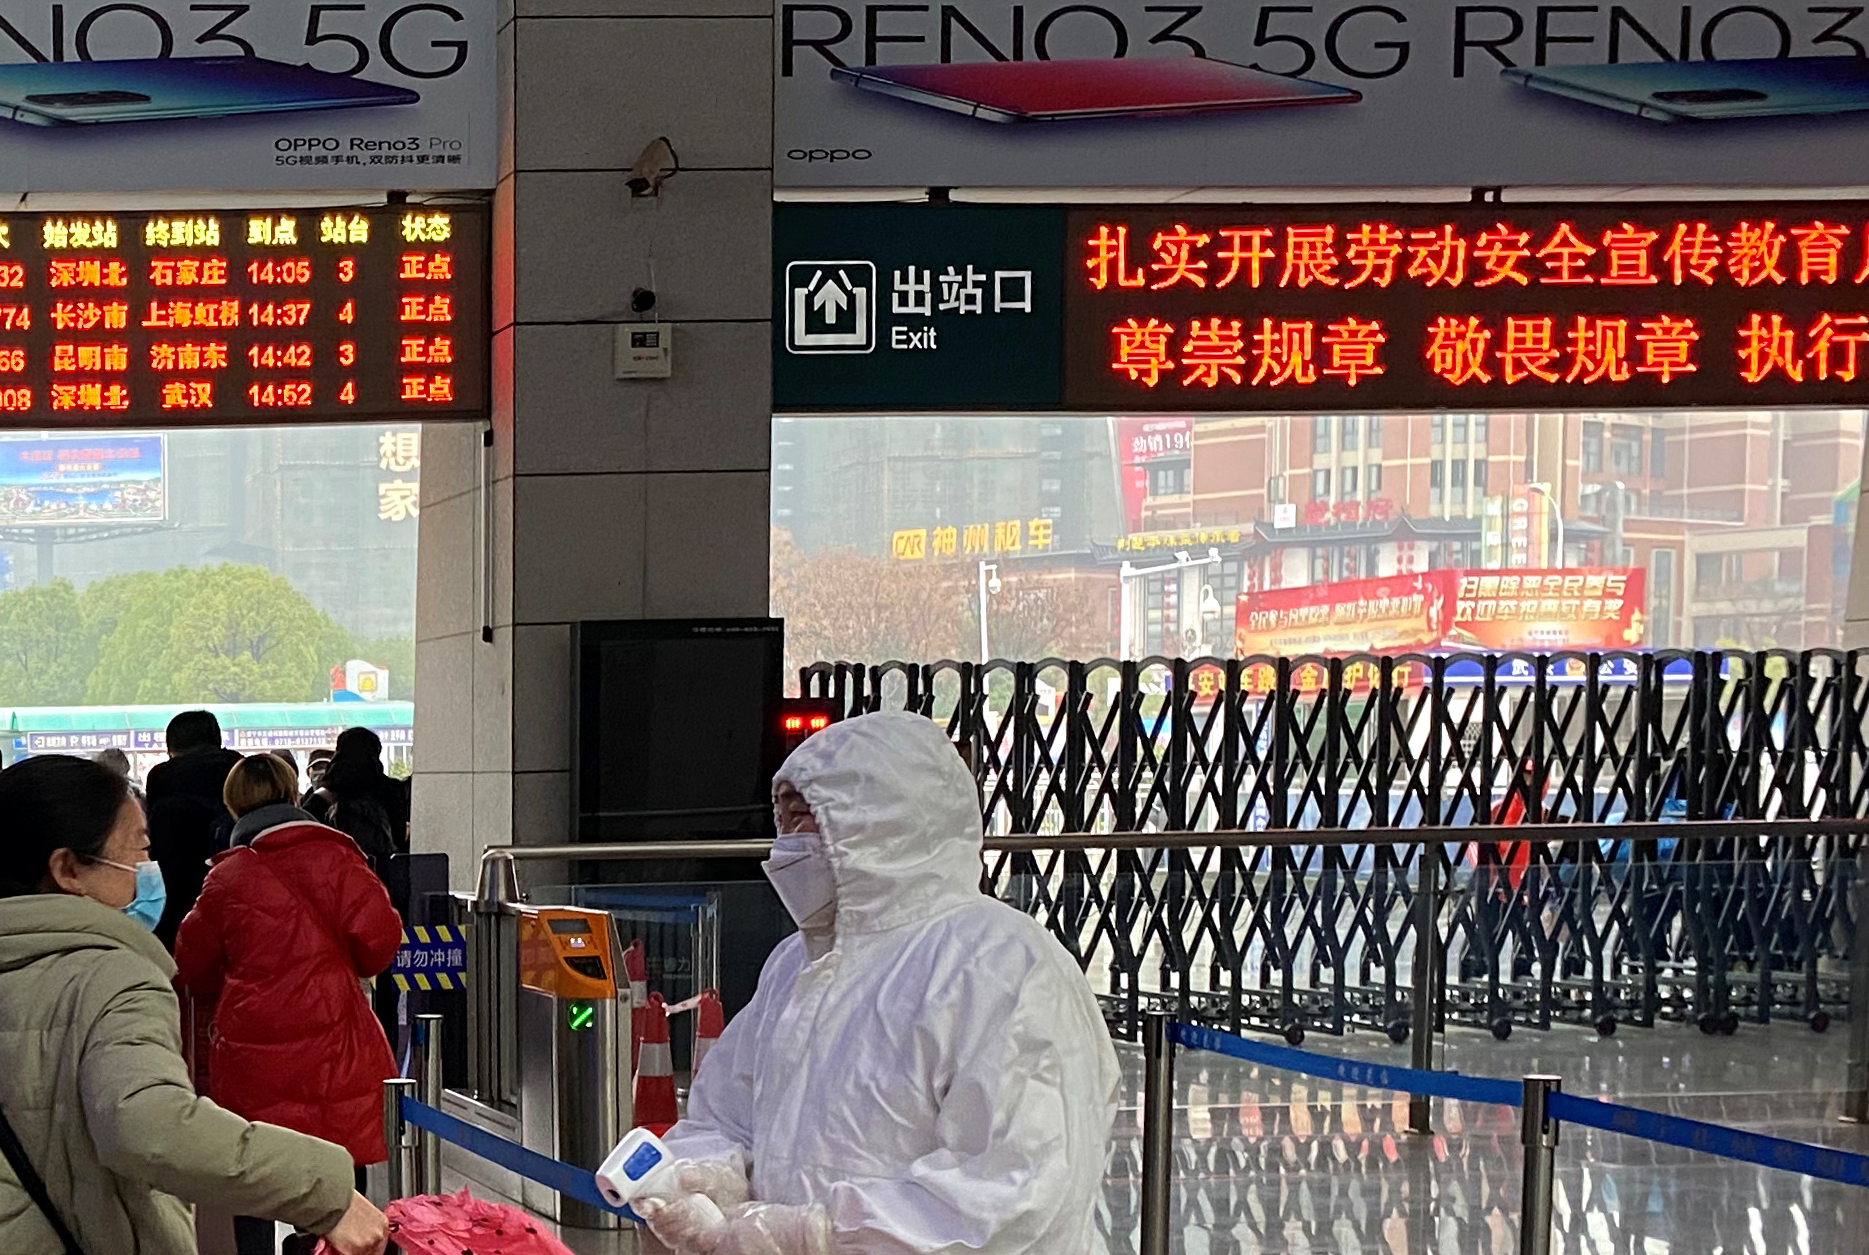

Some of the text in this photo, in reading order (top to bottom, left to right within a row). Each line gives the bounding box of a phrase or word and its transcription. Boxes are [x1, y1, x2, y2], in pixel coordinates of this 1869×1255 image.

[303, 3, 469, 80] 5G
[1250, 5, 1411, 80] 5G
[274, 136, 463, 151] OPPO Reno3 Pro
[42, 218, 118, 249] 始发站
[145, 217, 220, 247] 终到站
[247, 215, 298, 245] 到点
[320, 213, 370, 244] 站台
[401, 212, 452, 243] 状态
[48, 257, 129, 288] 深圳北
[149, 255, 228, 287] 石家庄
[247, 257, 311, 285] 14:05
[338, 258, 356, 283] 3
[399, 251, 453, 281] 正点
[1086, 220, 1869, 290] 扎实开展劳动安全宣传教育
[892, 264, 1032, 316] 出站口
[49, 299, 129, 330] 长沙南
[246, 300, 312, 327] 14:37
[338, 299, 355, 325] 4
[399, 293, 454, 323] 正点
[51, 341, 130, 373] 昆明南
[149, 340, 228, 371] 济南东
[247, 342, 313, 369] 14:42
[338, 342, 356, 367] 3
[399, 335, 454, 364] 正点
[891, 326, 937, 349] Exit
[1111, 315, 1387, 388] 尊崇规章
[1425, 314, 1701, 387] 敬畏规章
[50, 380, 131, 412] 深圳北
[160, 379, 213, 410] 武汉
[247, 381, 313, 408] 14:52
[338, 380, 357, 405] 4
[400, 374, 454, 403] 正点
[377, 430, 422, 522] 想家
[932, 518, 1053, 557] 神州租车
[396, 948, 463, 968] 请勿冲撞
